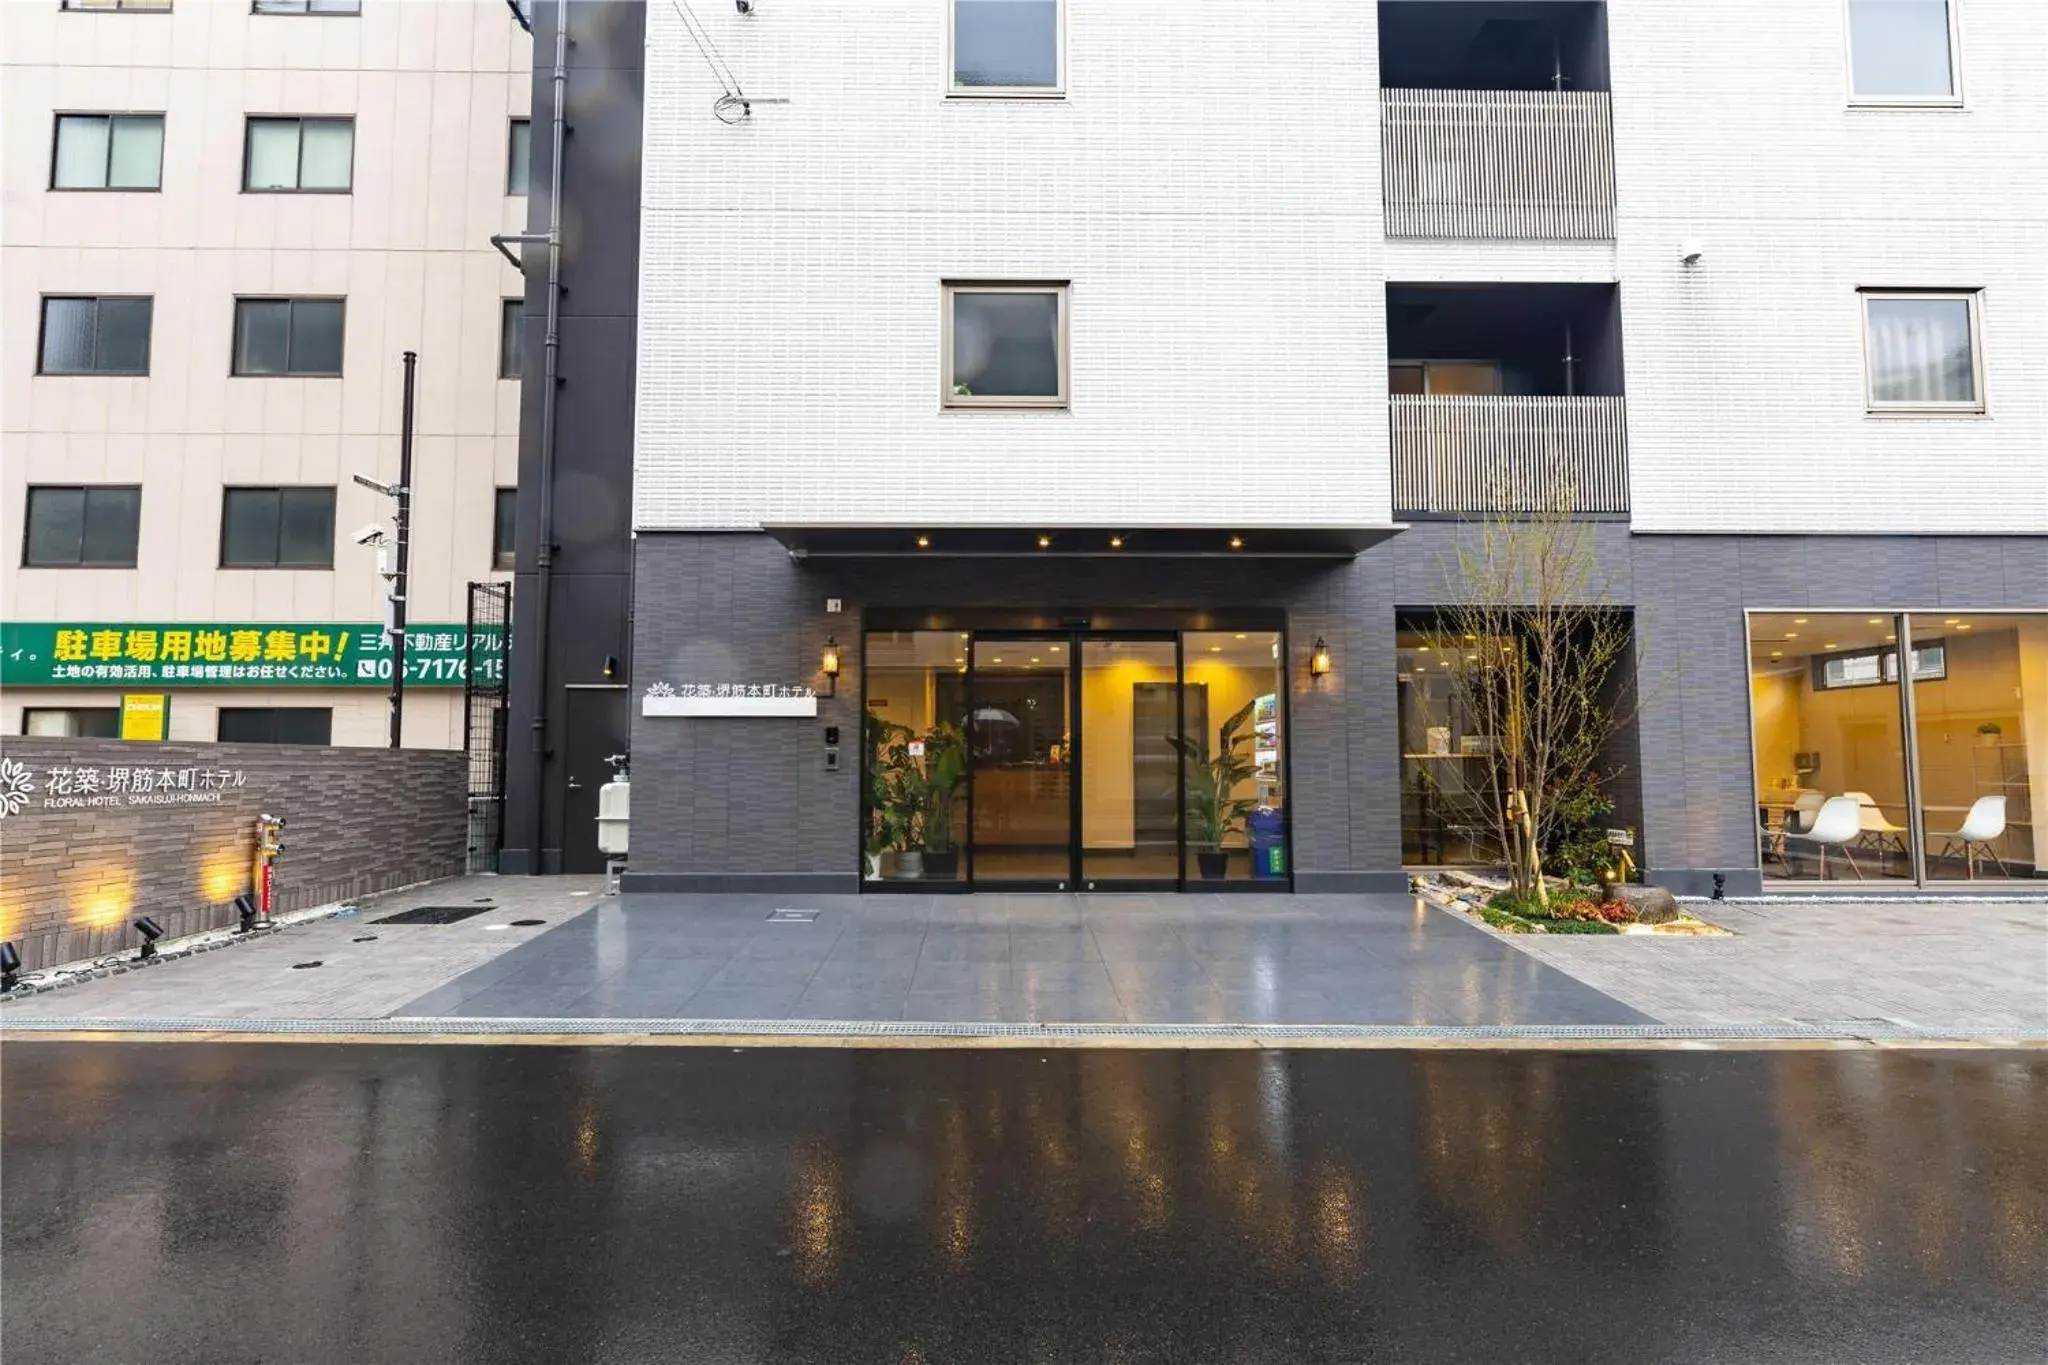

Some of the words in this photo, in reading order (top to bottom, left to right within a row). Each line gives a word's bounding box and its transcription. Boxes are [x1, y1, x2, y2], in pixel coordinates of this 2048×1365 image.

[53, 630, 350, 662] 駐車場用地募集中！
[51, 665, 348, 679] 土地の有効活用、駐車場管理はお任せください。
[44, 796, 83, 808] FLORAL
[87, 795, 121, 807] HOTEL
